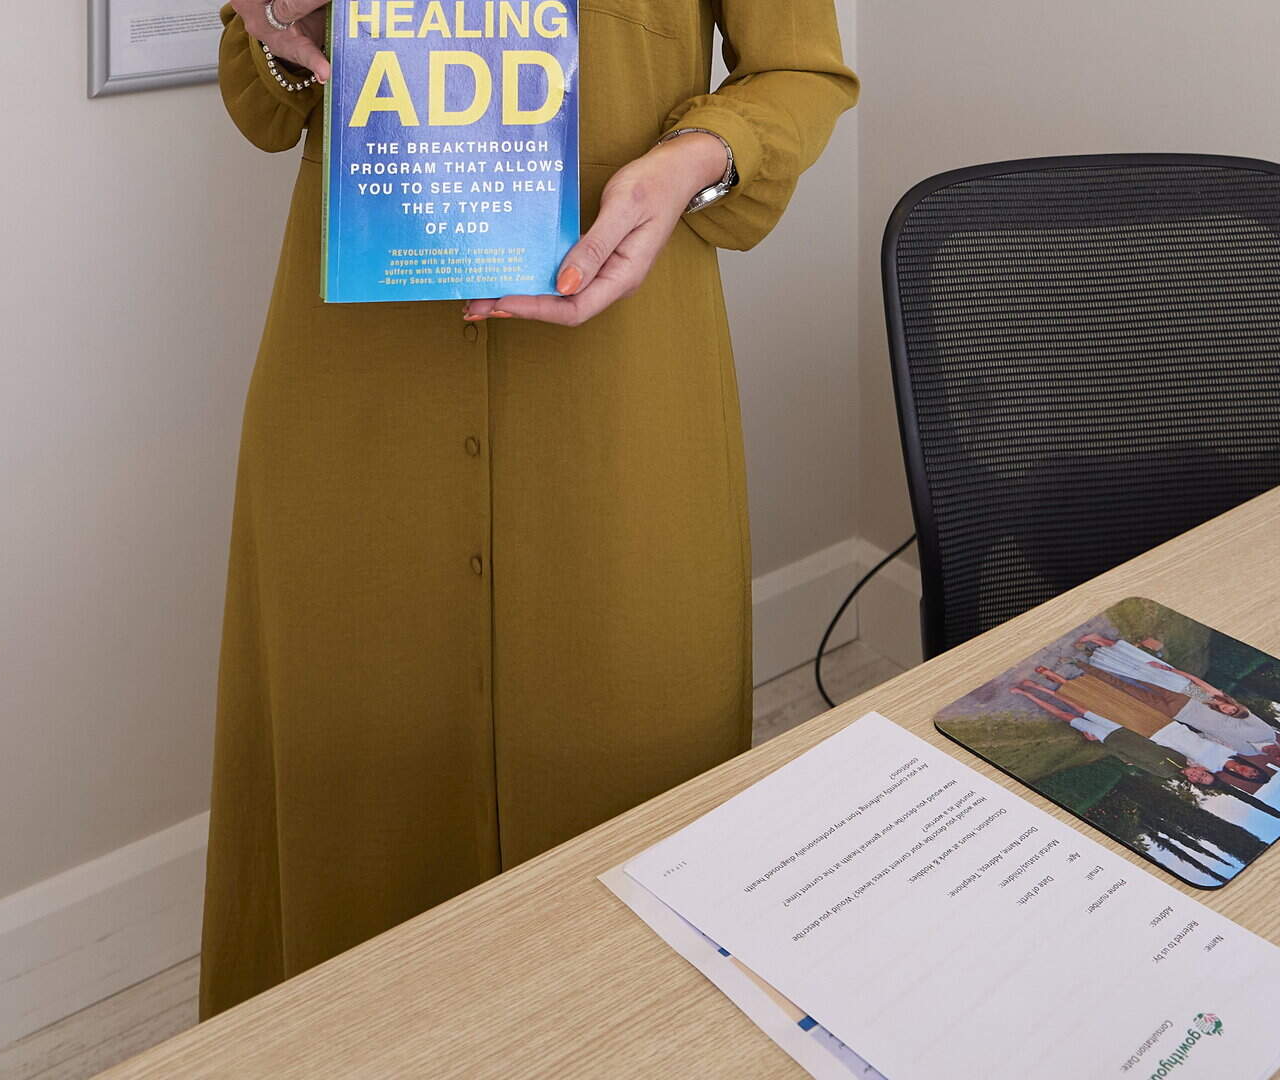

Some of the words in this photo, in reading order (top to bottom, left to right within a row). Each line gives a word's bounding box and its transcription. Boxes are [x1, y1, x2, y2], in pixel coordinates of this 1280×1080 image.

[348, 0, 568, 38] HEALING
[348, 50, 565, 127] ADD
[366, 142, 399, 154] THE
[407, 140, 549, 154] BREAKTHROUGH
[350, 162, 436, 175] PROGRAM
[444, 161, 487, 173] THAT
[494, 160, 564, 173] ALLOWS
[358, 183, 393, 195] YOU
[401, 183, 422, 194] TO
[431, 182, 463, 193] SEE
[470, 181, 505, 193] AND
[512, 180, 556, 192] HEAL
[401, 202, 434, 214] THE
[442, 202, 451, 214] 7
[459, 201, 513, 213] TYPES
[425, 222, 447, 235] OF
[455, 221, 489, 234] ADD
[972, 805, 1007, 834] Occupation,
[957, 829, 976, 846] Hours
[1017, 824, 1038, 843] Doctor
[937, 846, 953, 861] work
[999, 838, 1020, 857] Name,
[1037, 837, 1059, 857] Marital
[976, 852, 1003, 875] Address,
[1065, 850, 1081, 866] Age:
[906, 861, 934, 885] Hobbies:
[997, 852, 1040, 890] status/children:
[1084, 864, 1103, 882] Email:
[946, 870, 980, 900] Telephone:
[1030, 885, 1040, 895] of
[1037, 873, 1054, 890] Date
[1105, 877, 1126, 896] Phone
[1015, 890, 1034, 907] birth:
[1084, 892, 1109, 915] number:
[1149, 905, 1174, 928] Address:
[1173, 919, 1199, 944] Referred
[1160, 948, 1169, 956] us
[1167, 940, 1177, 950] to
[1202, 933, 1224, 954] Name:
[1134, 1018, 1174, 1058] Consultation
